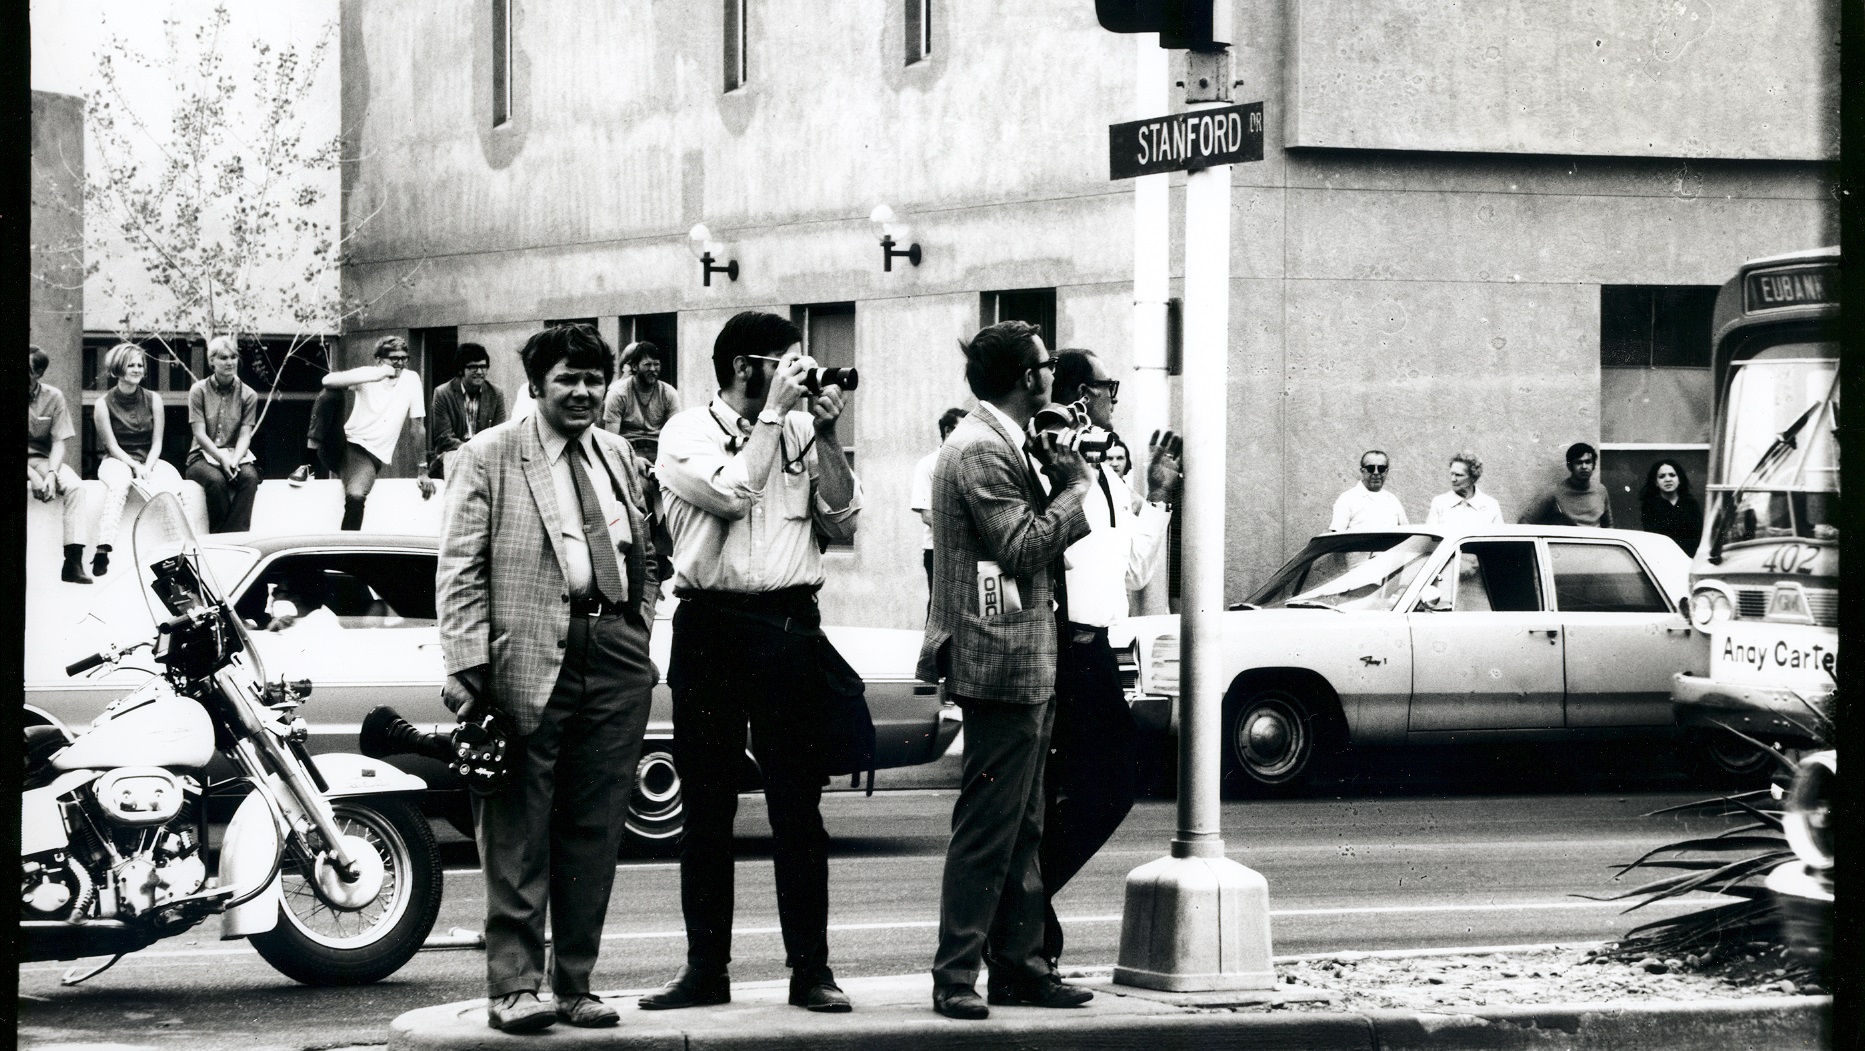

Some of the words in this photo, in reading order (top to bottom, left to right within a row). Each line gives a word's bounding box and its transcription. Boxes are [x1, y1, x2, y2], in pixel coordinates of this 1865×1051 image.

[1137, 112, 1242, 165] STANFORD
[1250, 111, 1262, 132] DR
[1761, 544, 1820, 575] 402
